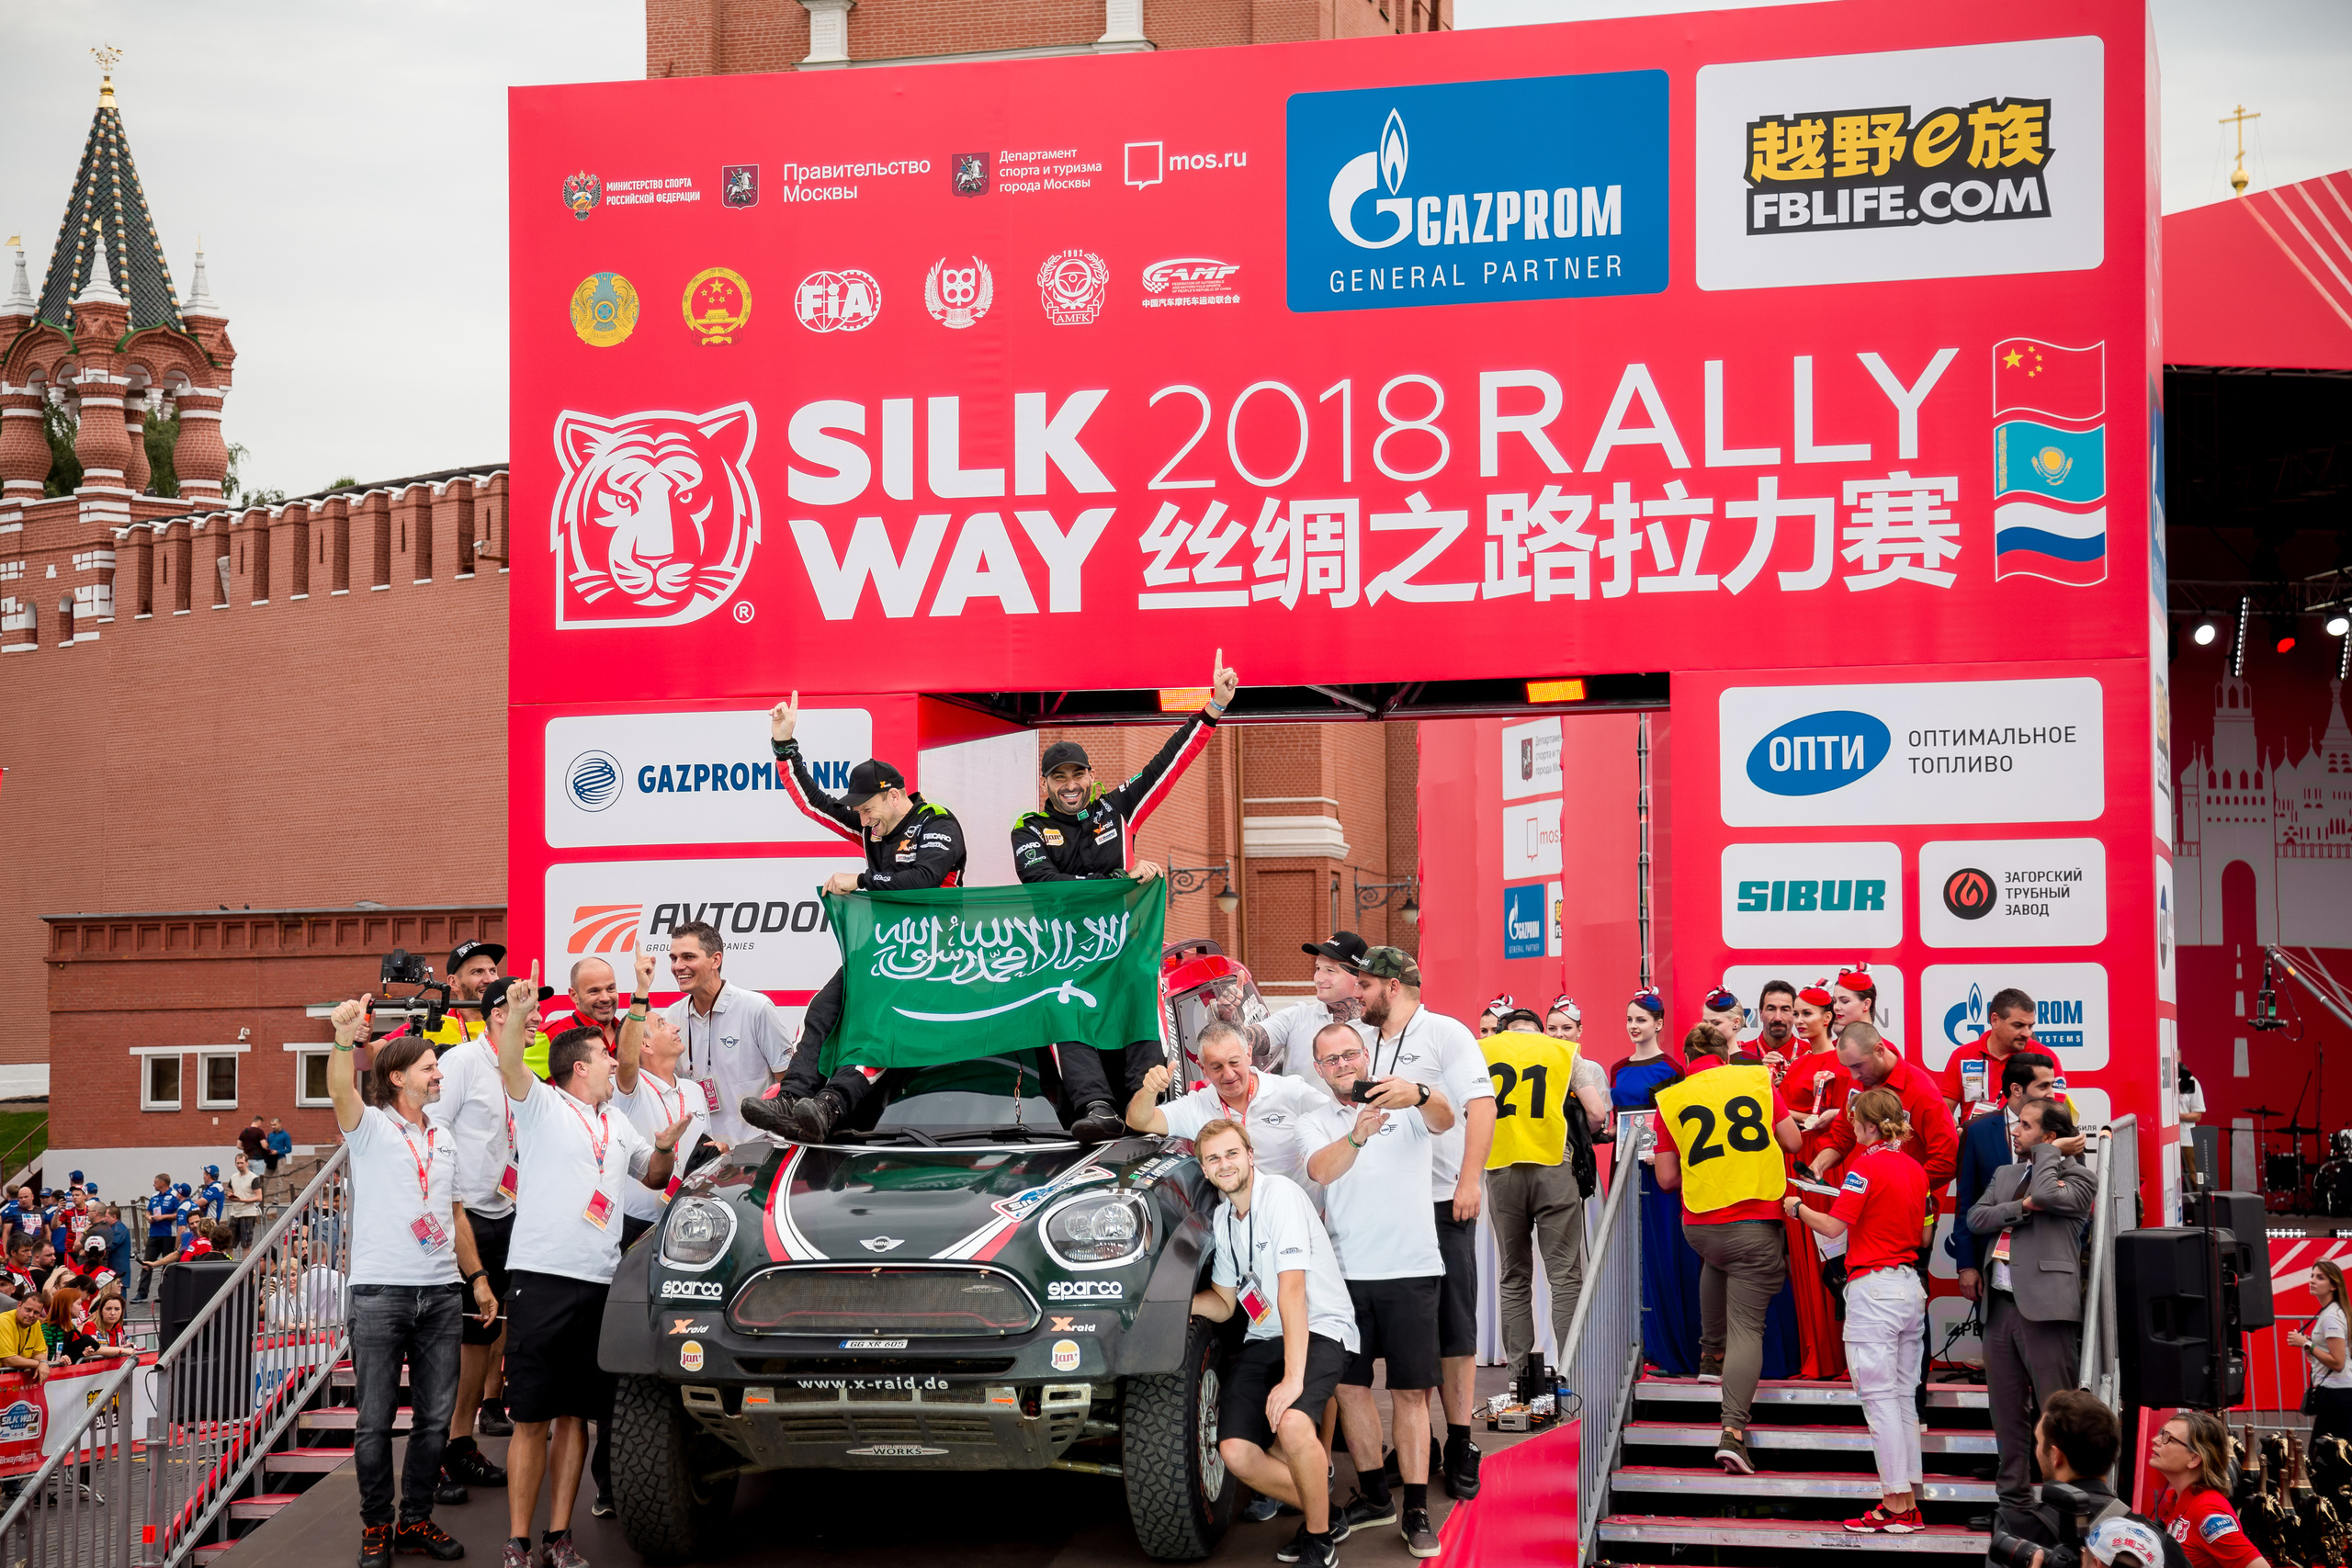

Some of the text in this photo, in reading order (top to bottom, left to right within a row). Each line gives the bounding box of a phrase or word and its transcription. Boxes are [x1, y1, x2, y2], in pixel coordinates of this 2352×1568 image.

[1749, 97, 2048, 186] 越野e族
[999, 149, 1078, 164] Департамент
[1169, 152, 1247, 171] mos.ru
[784, 159, 931, 186] Правительство
[999, 163, 1102, 179] спорта и туризма
[606, 177, 693, 192] МИНИСТЕРСТВО СПОРТА
[784, 185, 858, 203] Москвы
[999, 178, 1091, 194] города Москвы
[606, 190, 701, 206] РОССИЙСКОЙ ФЕДЕРАЦИИ
[1753, 176, 2044, 233] FBLIFE.COM
[1417, 184, 1622, 245] GAZPROM
[1063, 249, 1083, 258] 1992
[1329, 254, 1623, 293] GENERAL PARTNER
[1057, 312, 1091, 323] AMFK
[1148, 347, 1960, 491] 2018 RALLY
[787, 389, 1117, 506] SILK
[1137, 469, 1962, 611] 丝绸之路拉力赛
[787, 507, 1117, 621] WAY
[1908, 726, 2076, 748] ОПТИМАЛЬНОЕ
[1769, 735, 1865, 773] ОПТИ
[1908, 755, 2013, 774] ТОПЛИВО
[637, 760, 853, 794] GAZPROMNK
[2005, 867, 2083, 885] ЗАГОРСКИЙ
[1736, 879, 1886, 912] SIBUR
[2005, 885, 2071, 900] ТРУБНЫЙ
[2005, 902, 2050, 918] ЗАВОД
[2037, 1034, 2082, 1044] YSTEMS
[1488, 1062, 1548, 1120] 21
[1679, 1095, 1770, 1158] 28
[661, 1280, 723, 1301] sparco
[1047, 1280, 1123, 1301] sparco
[797, 1376, 950, 1390] www.x-raid.de
[2, 1412, 38, 1426] SILK WAY
[0, 1452, 38, 1465] ilkwayrally.com
[872, 1448, 922, 1456] WORKS
